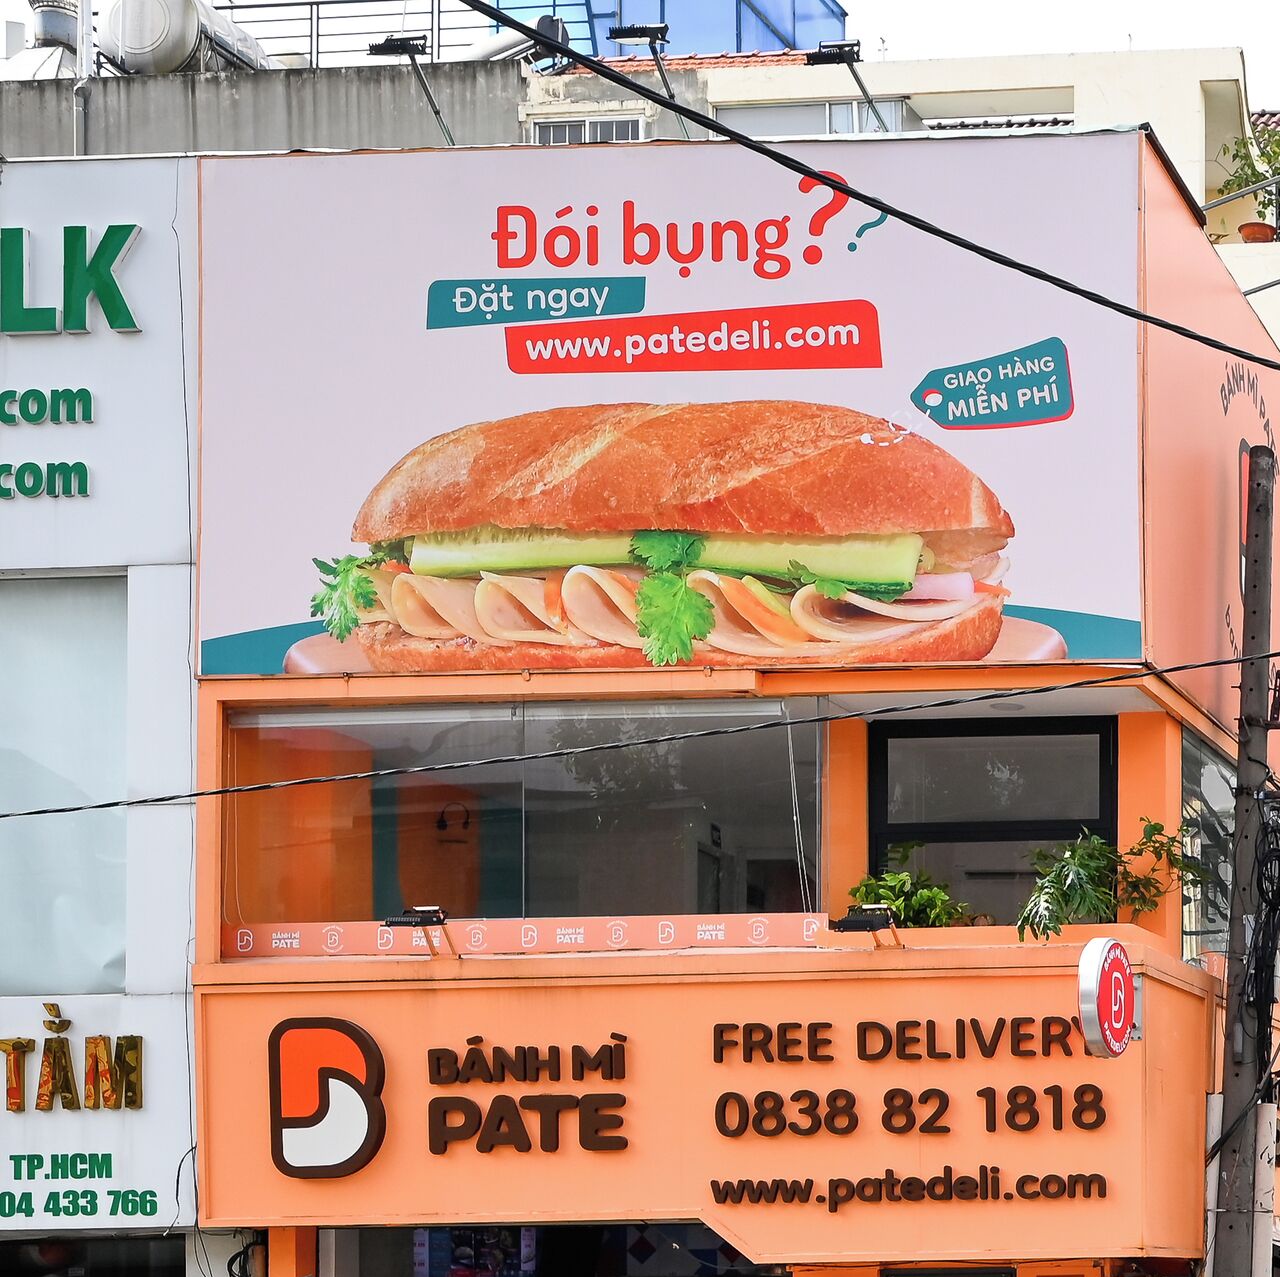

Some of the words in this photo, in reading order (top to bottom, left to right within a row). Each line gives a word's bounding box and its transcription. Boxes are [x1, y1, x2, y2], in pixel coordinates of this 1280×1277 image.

[490, 205, 599, 269] Đói
[452, 287, 513, 320] Đặt
[525, 286, 610, 315] ngay
[524, 318, 861, 364] www.patedeli.com
[942, 364, 995, 391] GIAO
[998, 352, 1057, 383] HÀNG
[947, 383, 1012, 423] MIỄN
[1017, 378, 1060, 412] PHÍ
[272, 939, 300, 948] PATE
[556, 935, 585, 945] PATE
[697, 931, 725, 941] PATE
[428, 1035, 560, 1086] BÁNH
[571, 1032, 628, 1082] MÌ
[712, 1021, 835, 1065] FREE
[428, 1093, 629, 1155] PATE
[714, 1088, 859, 1137] 0838
[881, 1086, 952, 1135] 82
[975, 1083, 1107, 1132] 1818
[10, 1153, 113, 1181] TP.HCM
[711, 1164, 1107, 1213] www.patedeli.com
[43, 1189, 99, 1216] 433
[107, 1189, 158, 1217] 766
